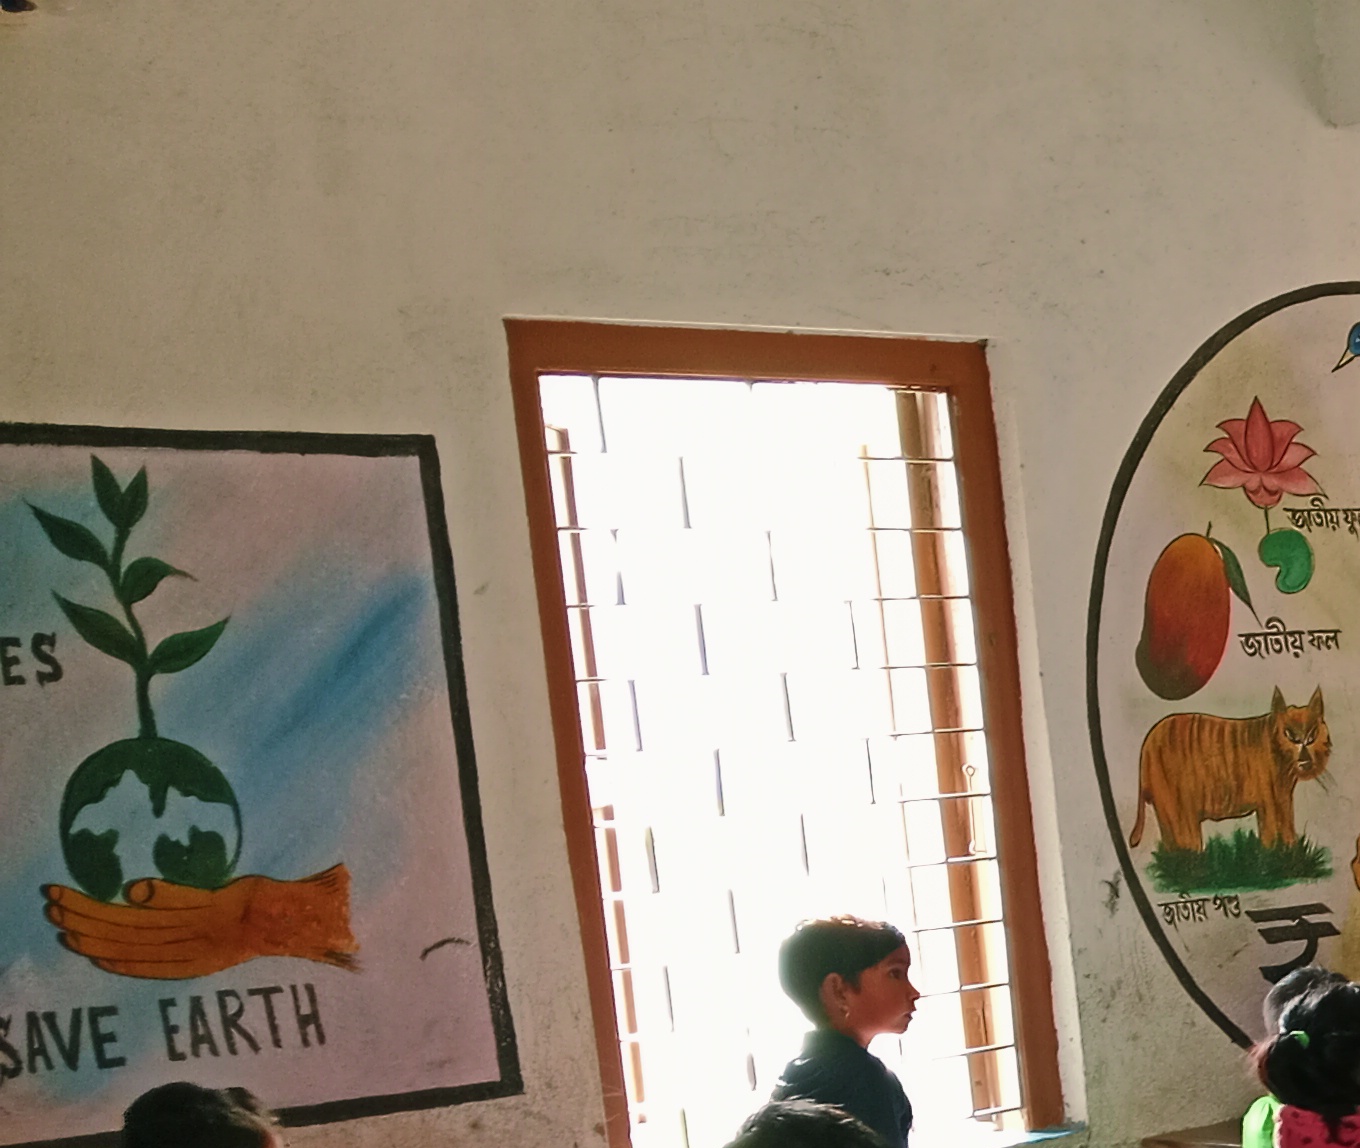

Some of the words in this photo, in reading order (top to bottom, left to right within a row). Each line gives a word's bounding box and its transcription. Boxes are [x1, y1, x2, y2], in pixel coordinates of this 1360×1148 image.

[1238, 616, 1305, 659] জাতীয়
[1307, 629, 1342, 651] ফল
[0, 1005, 127, 1087] SAVE
[159, 983, 327, 1062] EARTH
